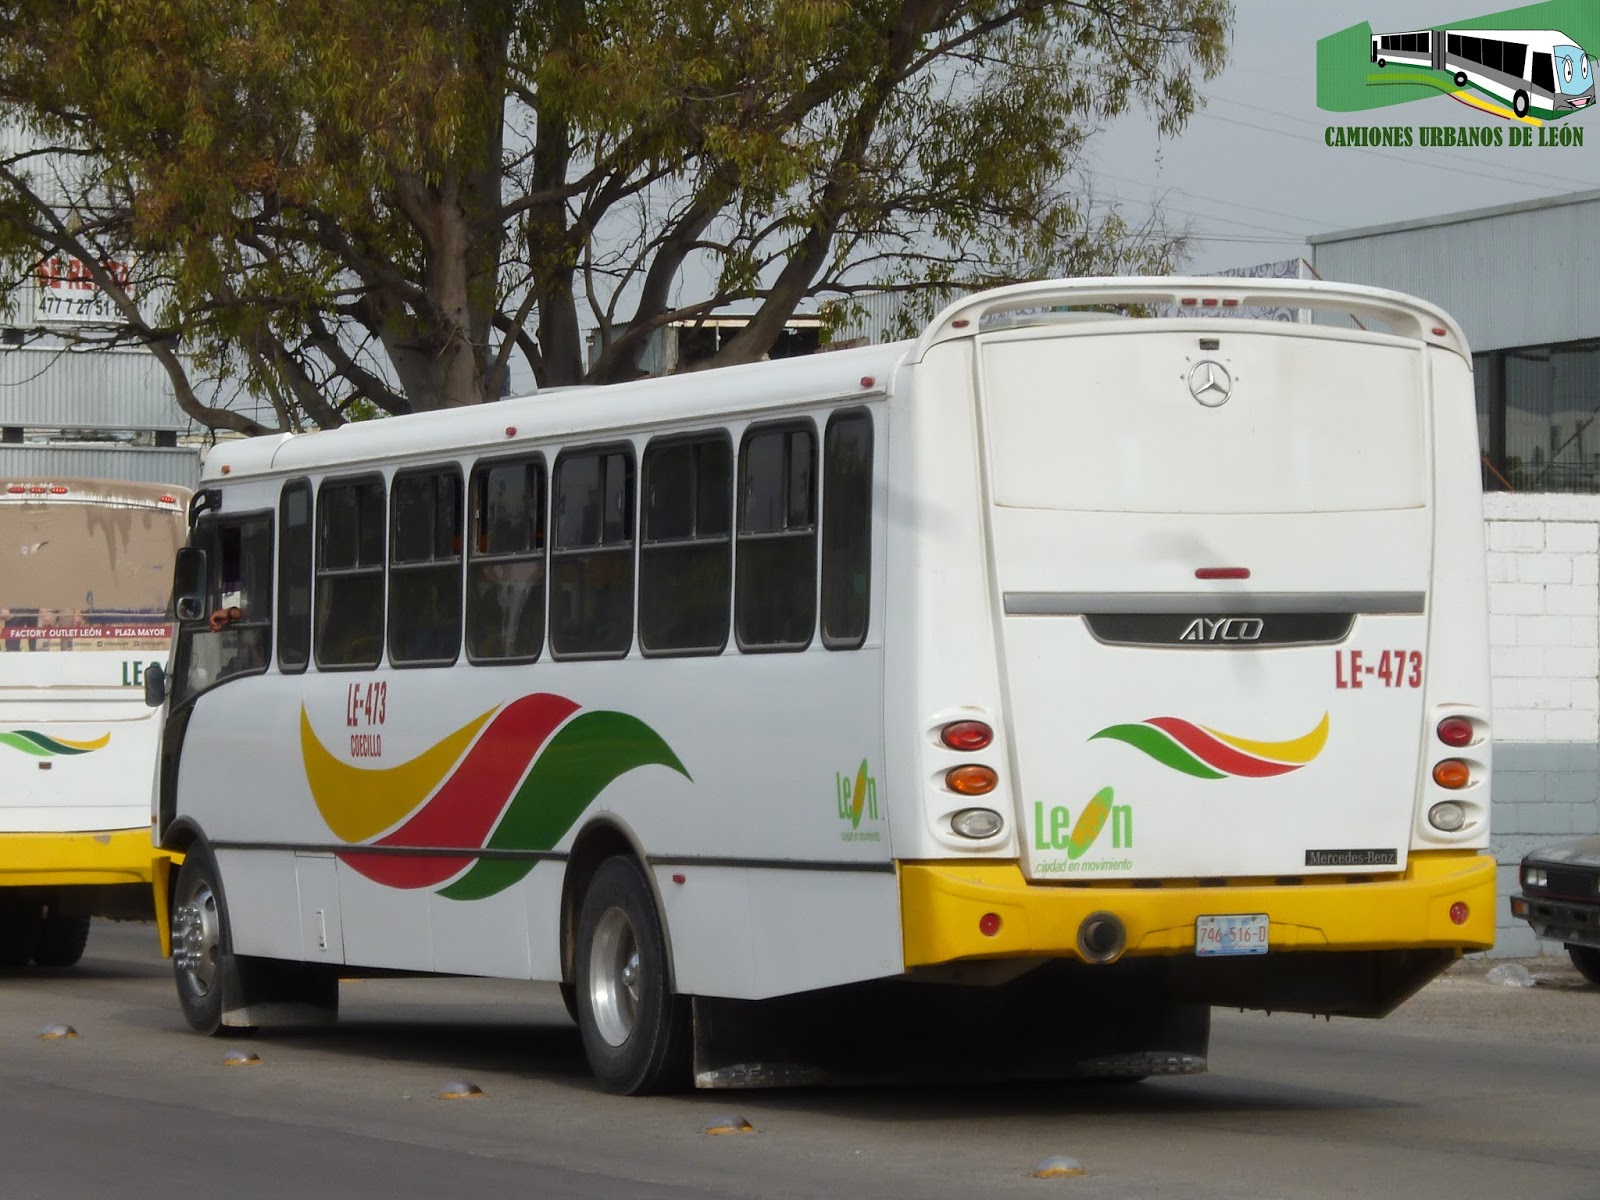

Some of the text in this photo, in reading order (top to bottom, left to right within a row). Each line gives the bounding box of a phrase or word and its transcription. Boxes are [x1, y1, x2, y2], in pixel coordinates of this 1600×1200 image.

[39, 297, 61, 314] 477
[65, 299, 73, 314] 7
[10, 627, 165, 638] FACTORY OUTLET LEÓN PLAZA MAYOR
[1335, 650, 1423, 689] LE-473
[346, 681, 387, 727] LE-473
[350, 734, 382, 757] COECILLO
[1068, 862, 1080, 872] en
[1081, 859, 1133, 871] movimiento
[1309, 851, 1395, 864] Mercedes-Benz
